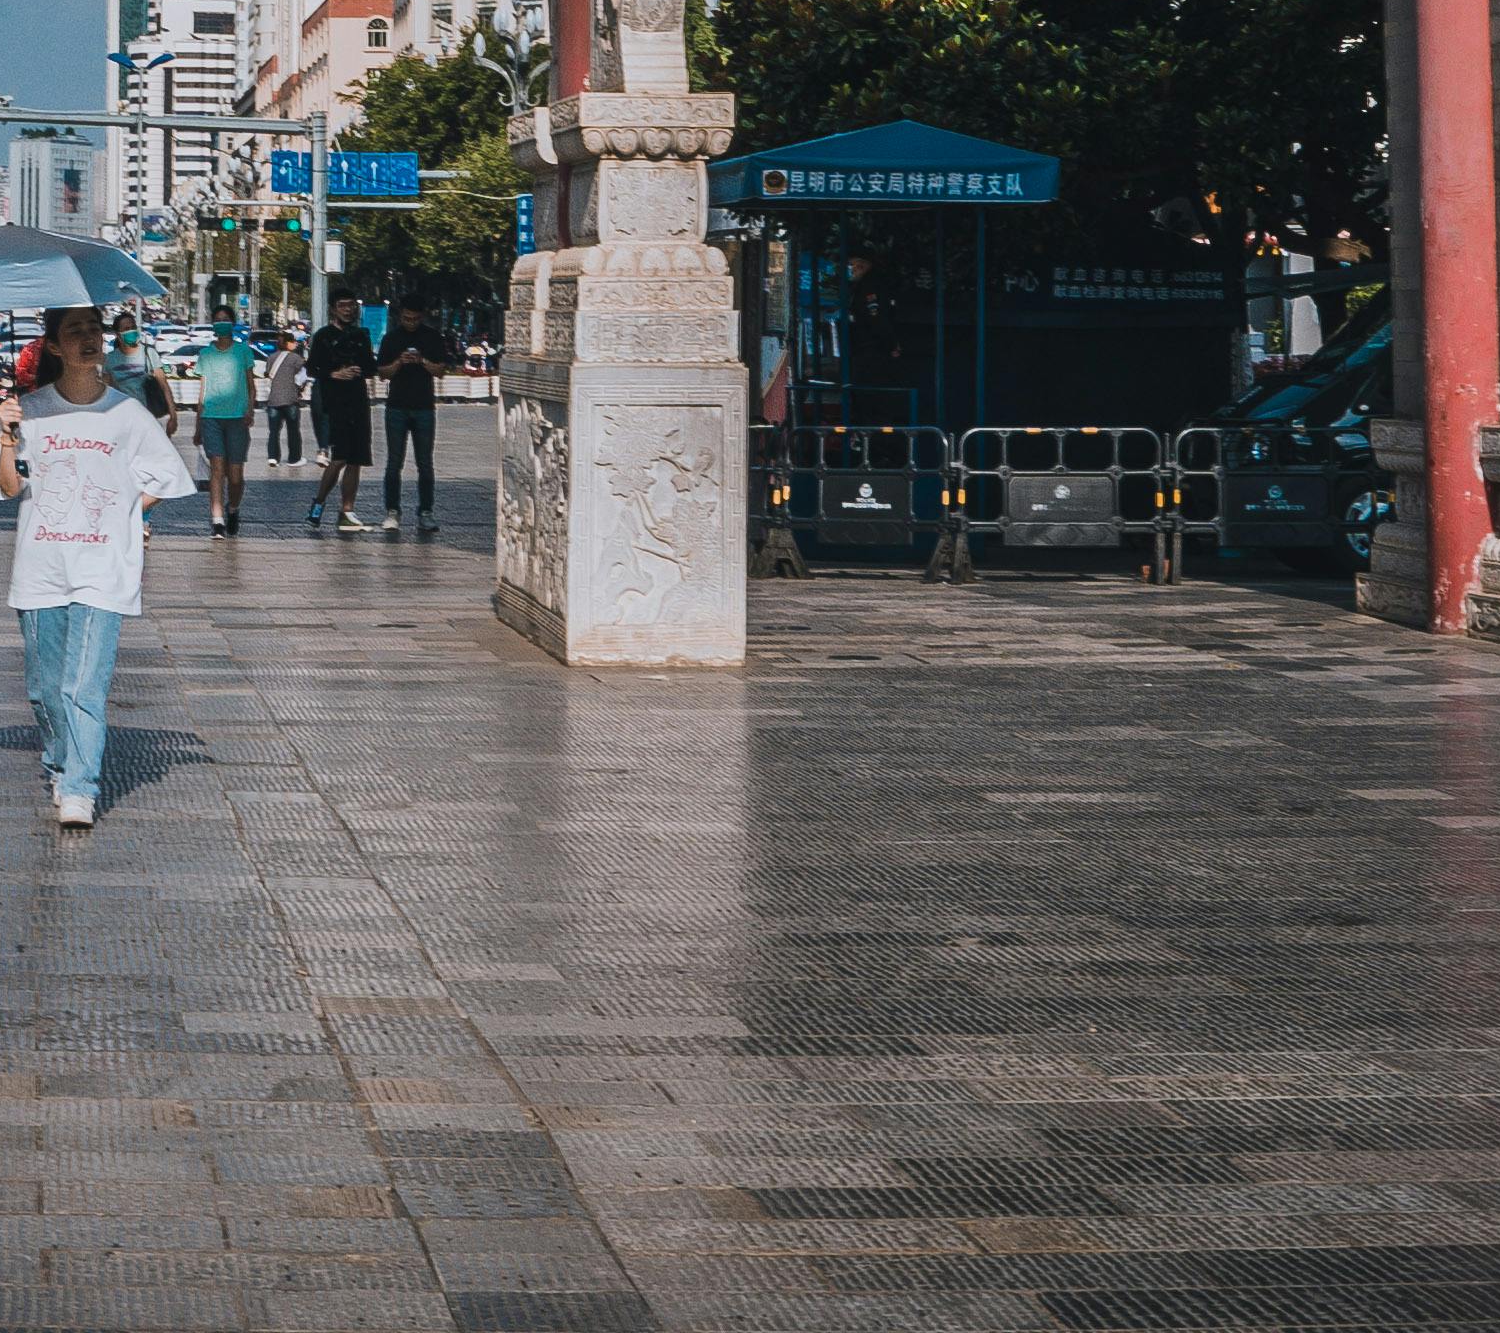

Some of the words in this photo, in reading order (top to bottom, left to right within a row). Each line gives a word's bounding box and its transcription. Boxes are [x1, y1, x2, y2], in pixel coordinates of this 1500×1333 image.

[790, 171, 1025, 197] 昆明市公安局特种警察支队
